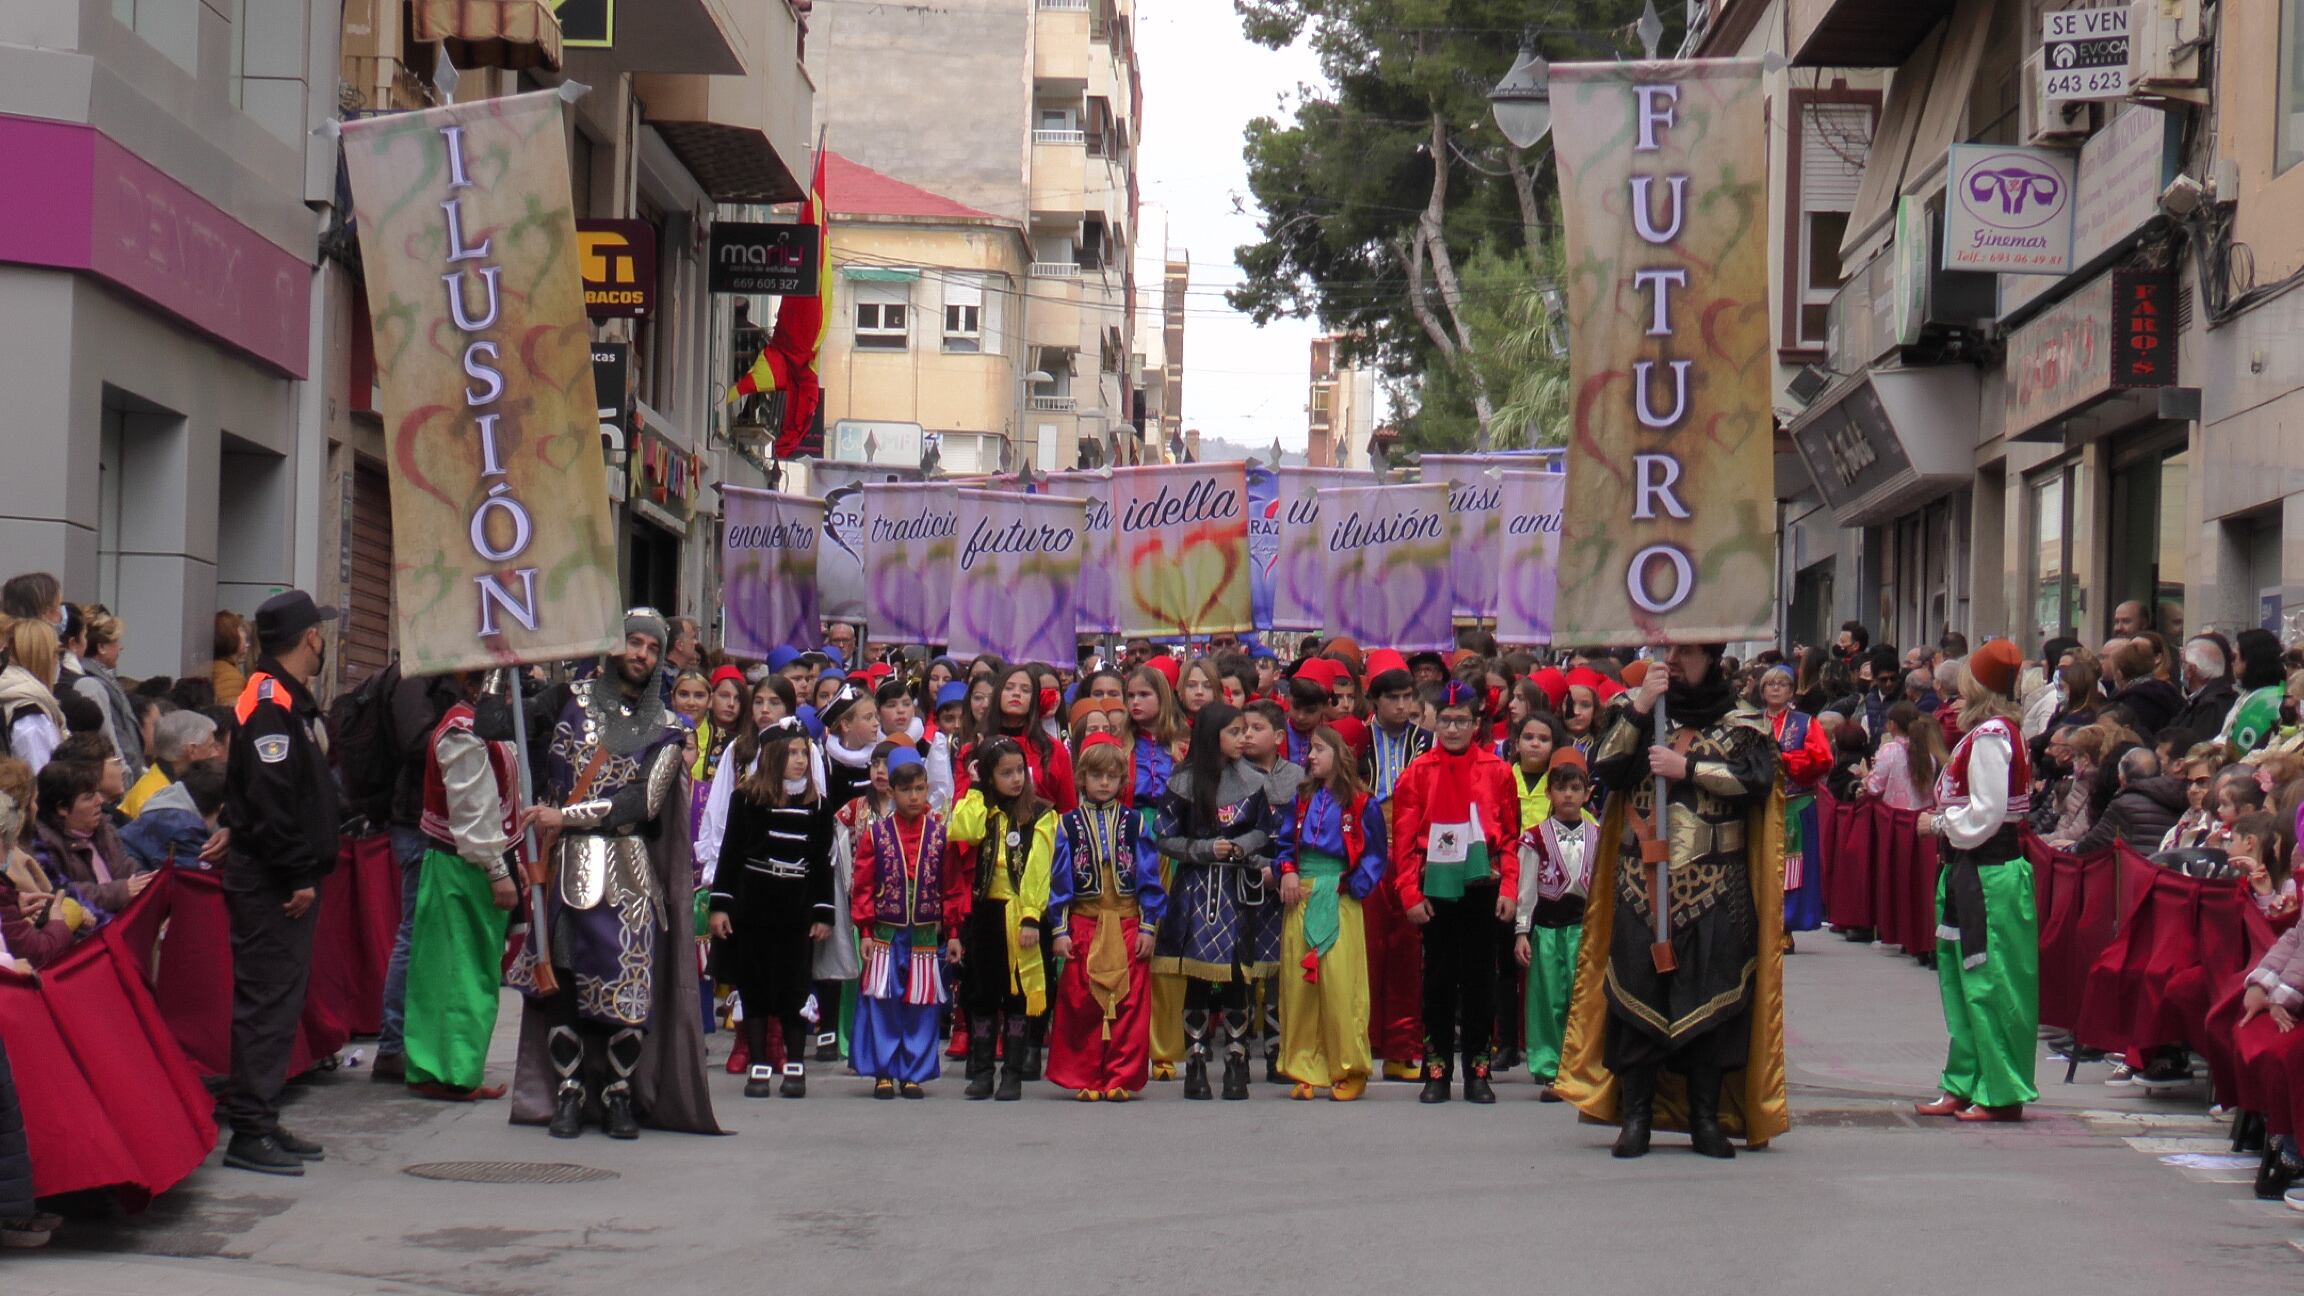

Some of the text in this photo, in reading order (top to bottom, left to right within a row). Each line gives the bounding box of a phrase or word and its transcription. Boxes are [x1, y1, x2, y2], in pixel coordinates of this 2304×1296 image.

[2053, 10, 2127, 35] SE VEN
[2080, 40, 2128, 56] EVOCA
[2047, 71, 2121, 94] 643 623
[1971, 229, 2048, 248] Ginemar
[584, 290, 644, 304] BACOS
[591, 353, 616, 362] cas
[1627, 84, 1693, 614] FUTURO
[440, 125, 539, 637] ILUSIÓN
[1122, 477, 1239, 532] idella
[728, 517, 815, 550] encuentro
[961, 515, 1075, 571] futuro
[1329, 508, 1443, 552] ilusión
